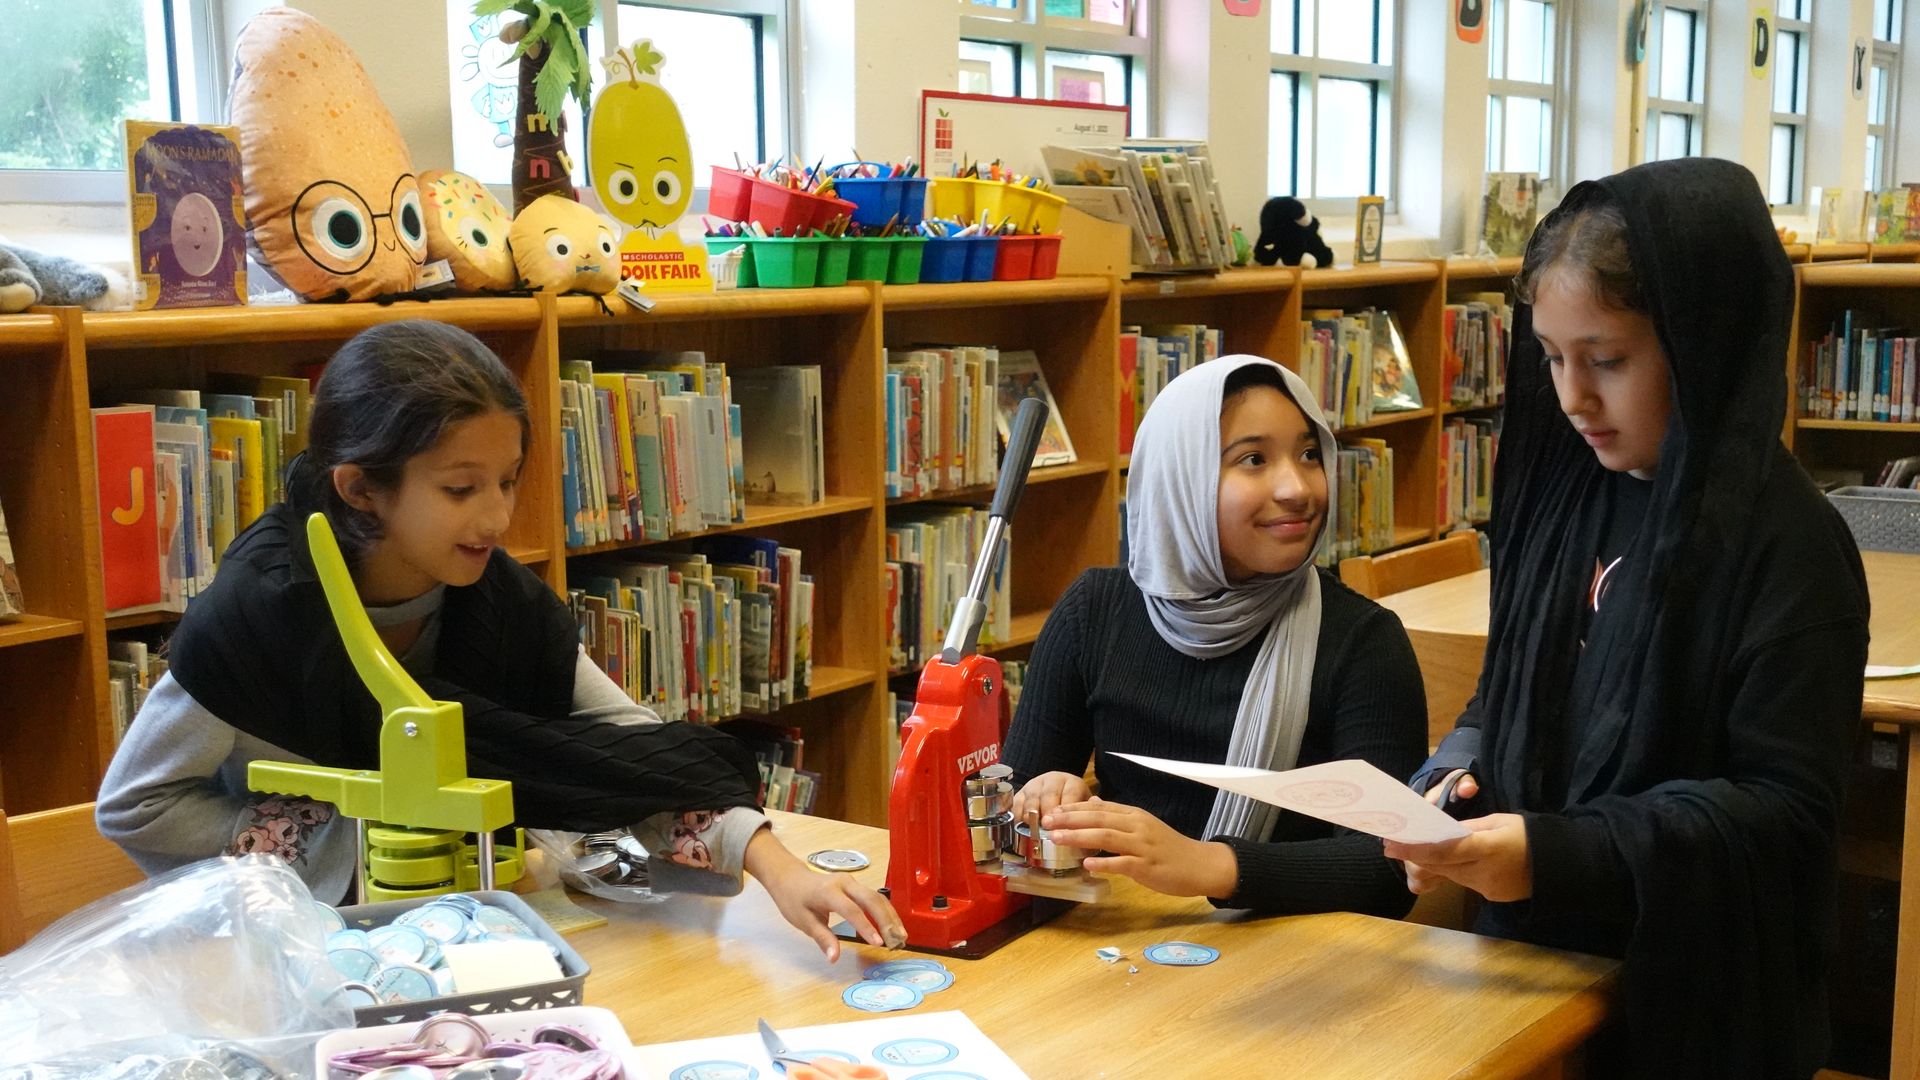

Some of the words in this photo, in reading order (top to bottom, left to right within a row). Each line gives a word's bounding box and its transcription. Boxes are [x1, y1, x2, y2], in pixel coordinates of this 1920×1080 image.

[1754, 17, 1769, 67] D
[1856, 45, 1866, 90] Y
[530, 159, 550, 178] n
[621, 264, 658, 280] OOK
[660, 264, 701, 279] FAIR
[111, 466, 145, 526] J
[957, 743, 998, 775] VEVOR
